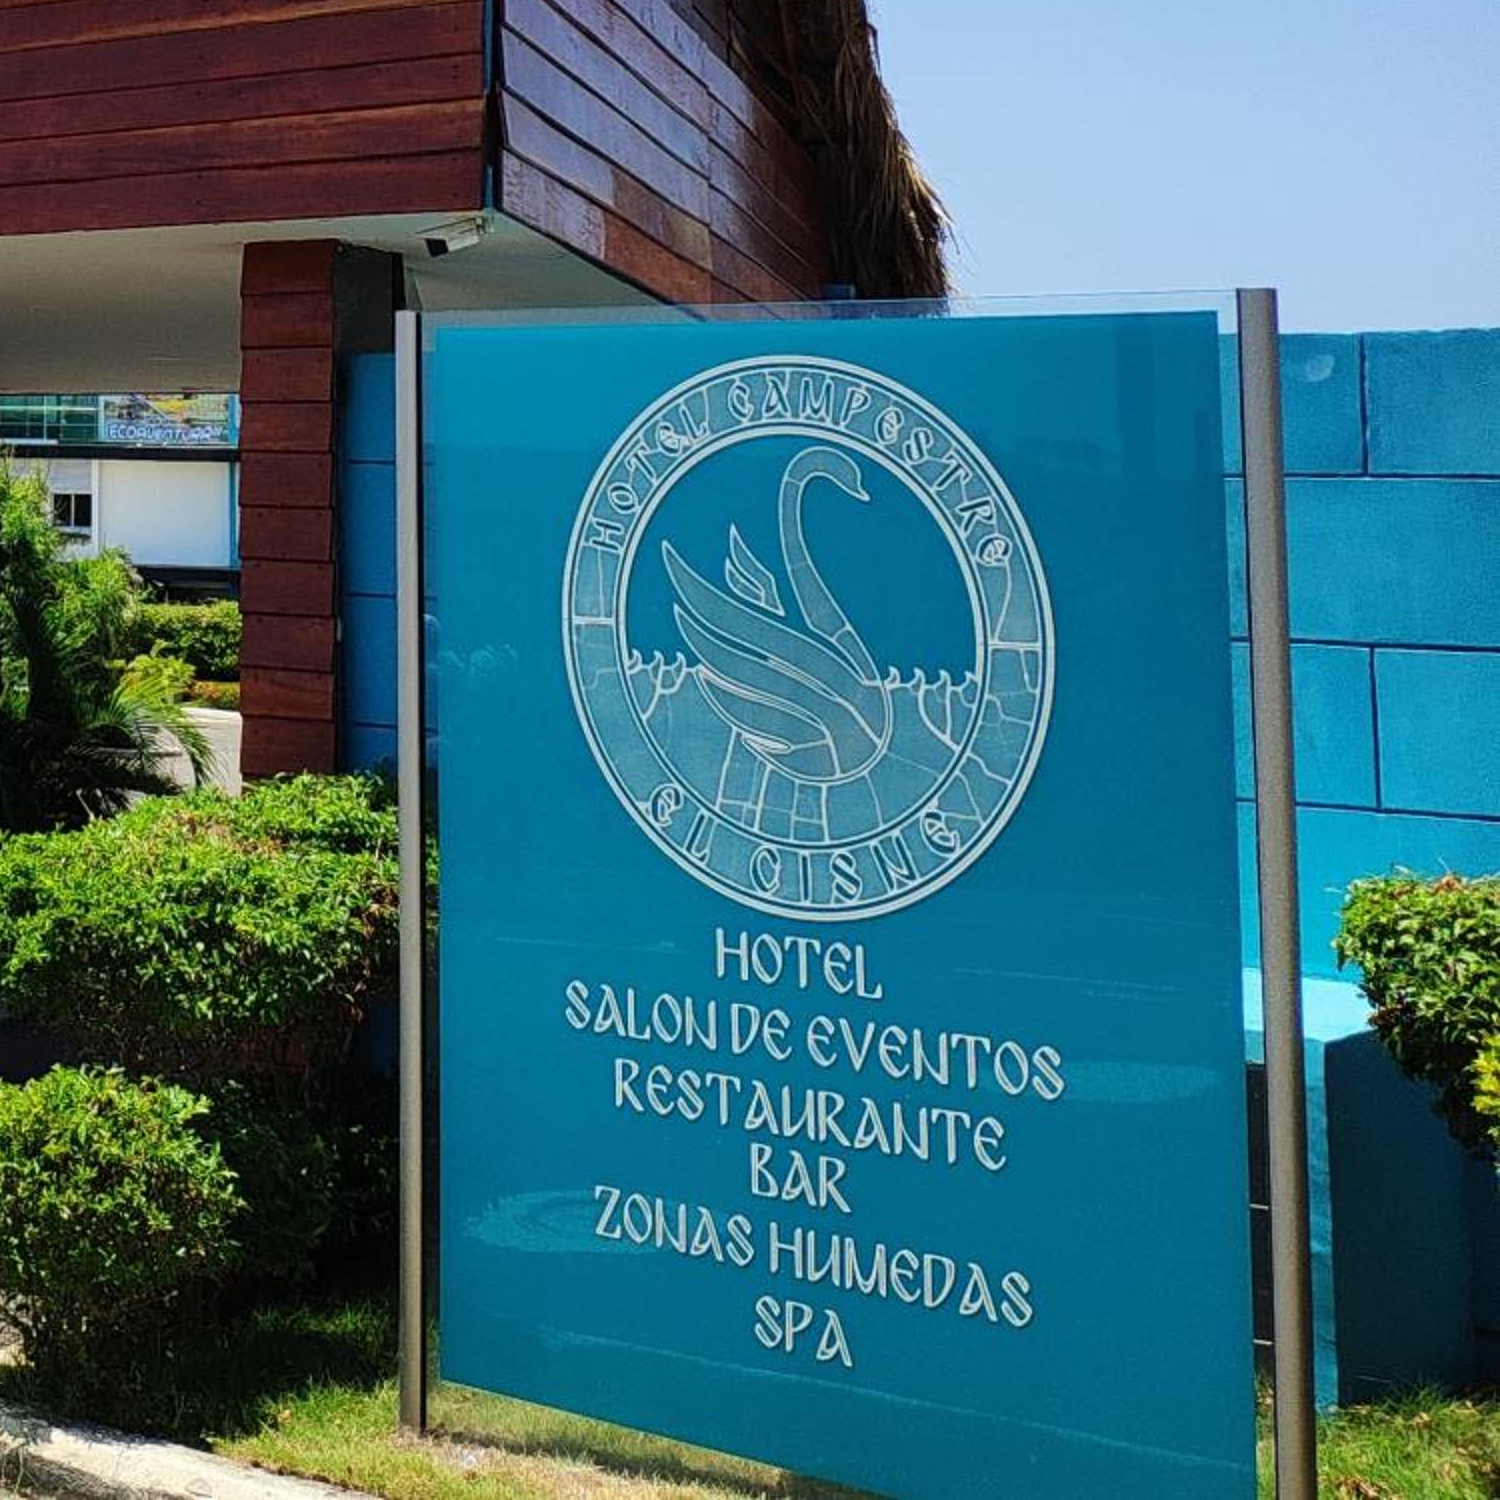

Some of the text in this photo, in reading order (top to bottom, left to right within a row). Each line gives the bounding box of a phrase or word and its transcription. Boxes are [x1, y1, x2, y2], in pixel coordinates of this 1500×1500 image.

[588, 377, 1013, 566] HOTEL CAMPESTRE
[651, 785, 961, 904] EL CISNE
[716, 927, 884, 1000] HOTEL
[564, 980, 1066, 1101] SALON DE EVENTOS
[613, 1058, 1007, 1171] RESTAURANTE
[749, 1143, 852, 1213] BAR
[594, 1185, 1035, 1328] ZONAS HUMEDAS
[755, 1296, 853, 1368] SPA
